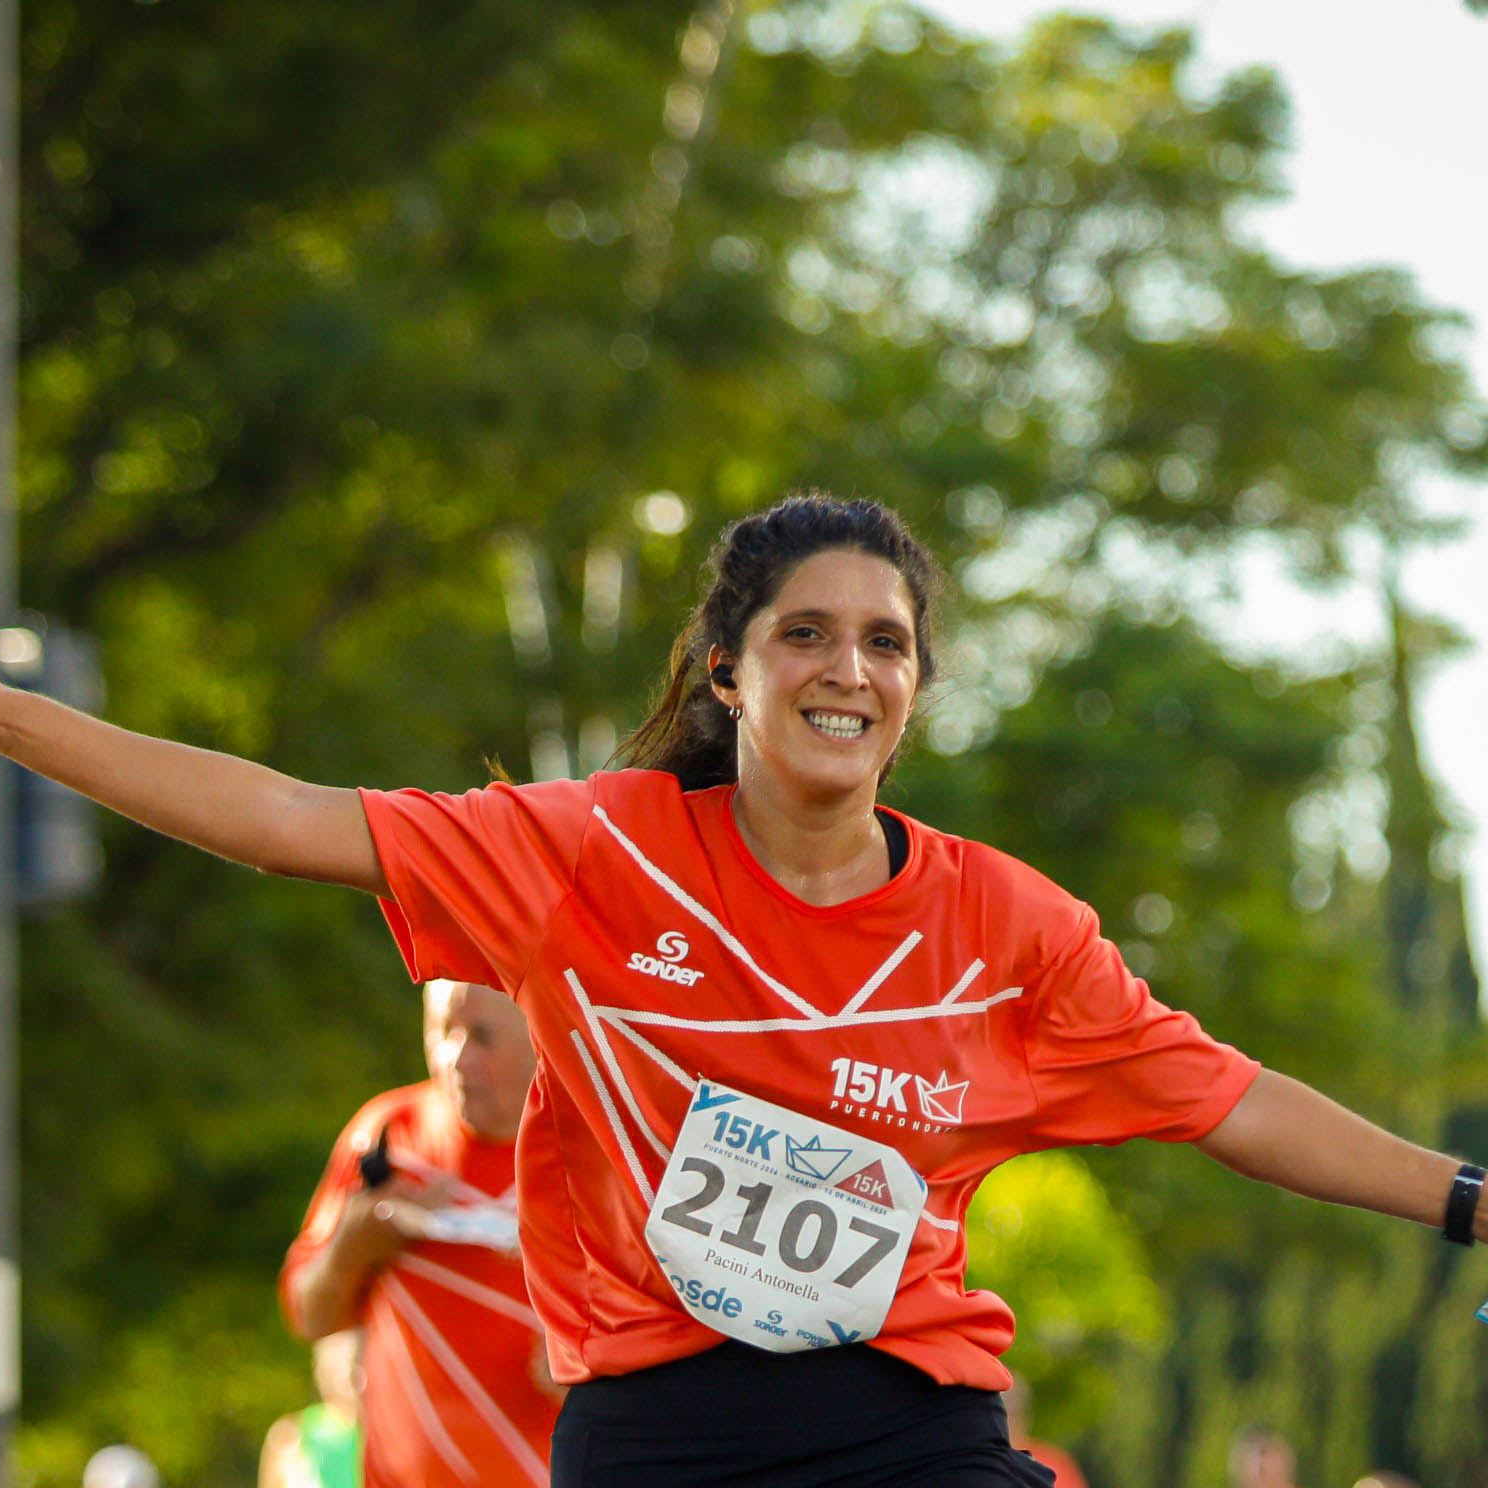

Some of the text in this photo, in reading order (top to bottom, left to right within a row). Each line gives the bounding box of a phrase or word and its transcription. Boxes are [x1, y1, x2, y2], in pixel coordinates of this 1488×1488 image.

[831, 1057, 912, 1112] 15K
[713, 1111, 781, 1160] 15K
[830, 1101, 906, 1127] PUERTO
[704, 1144, 732, 1158] PUERTO
[785, 1174, 817, 1188] ROSARIO
[853, 1173, 887, 1198] 15K
[661, 1156, 900, 1288] 2107
[704, 1248, 820, 1302] Pacini Antonella
